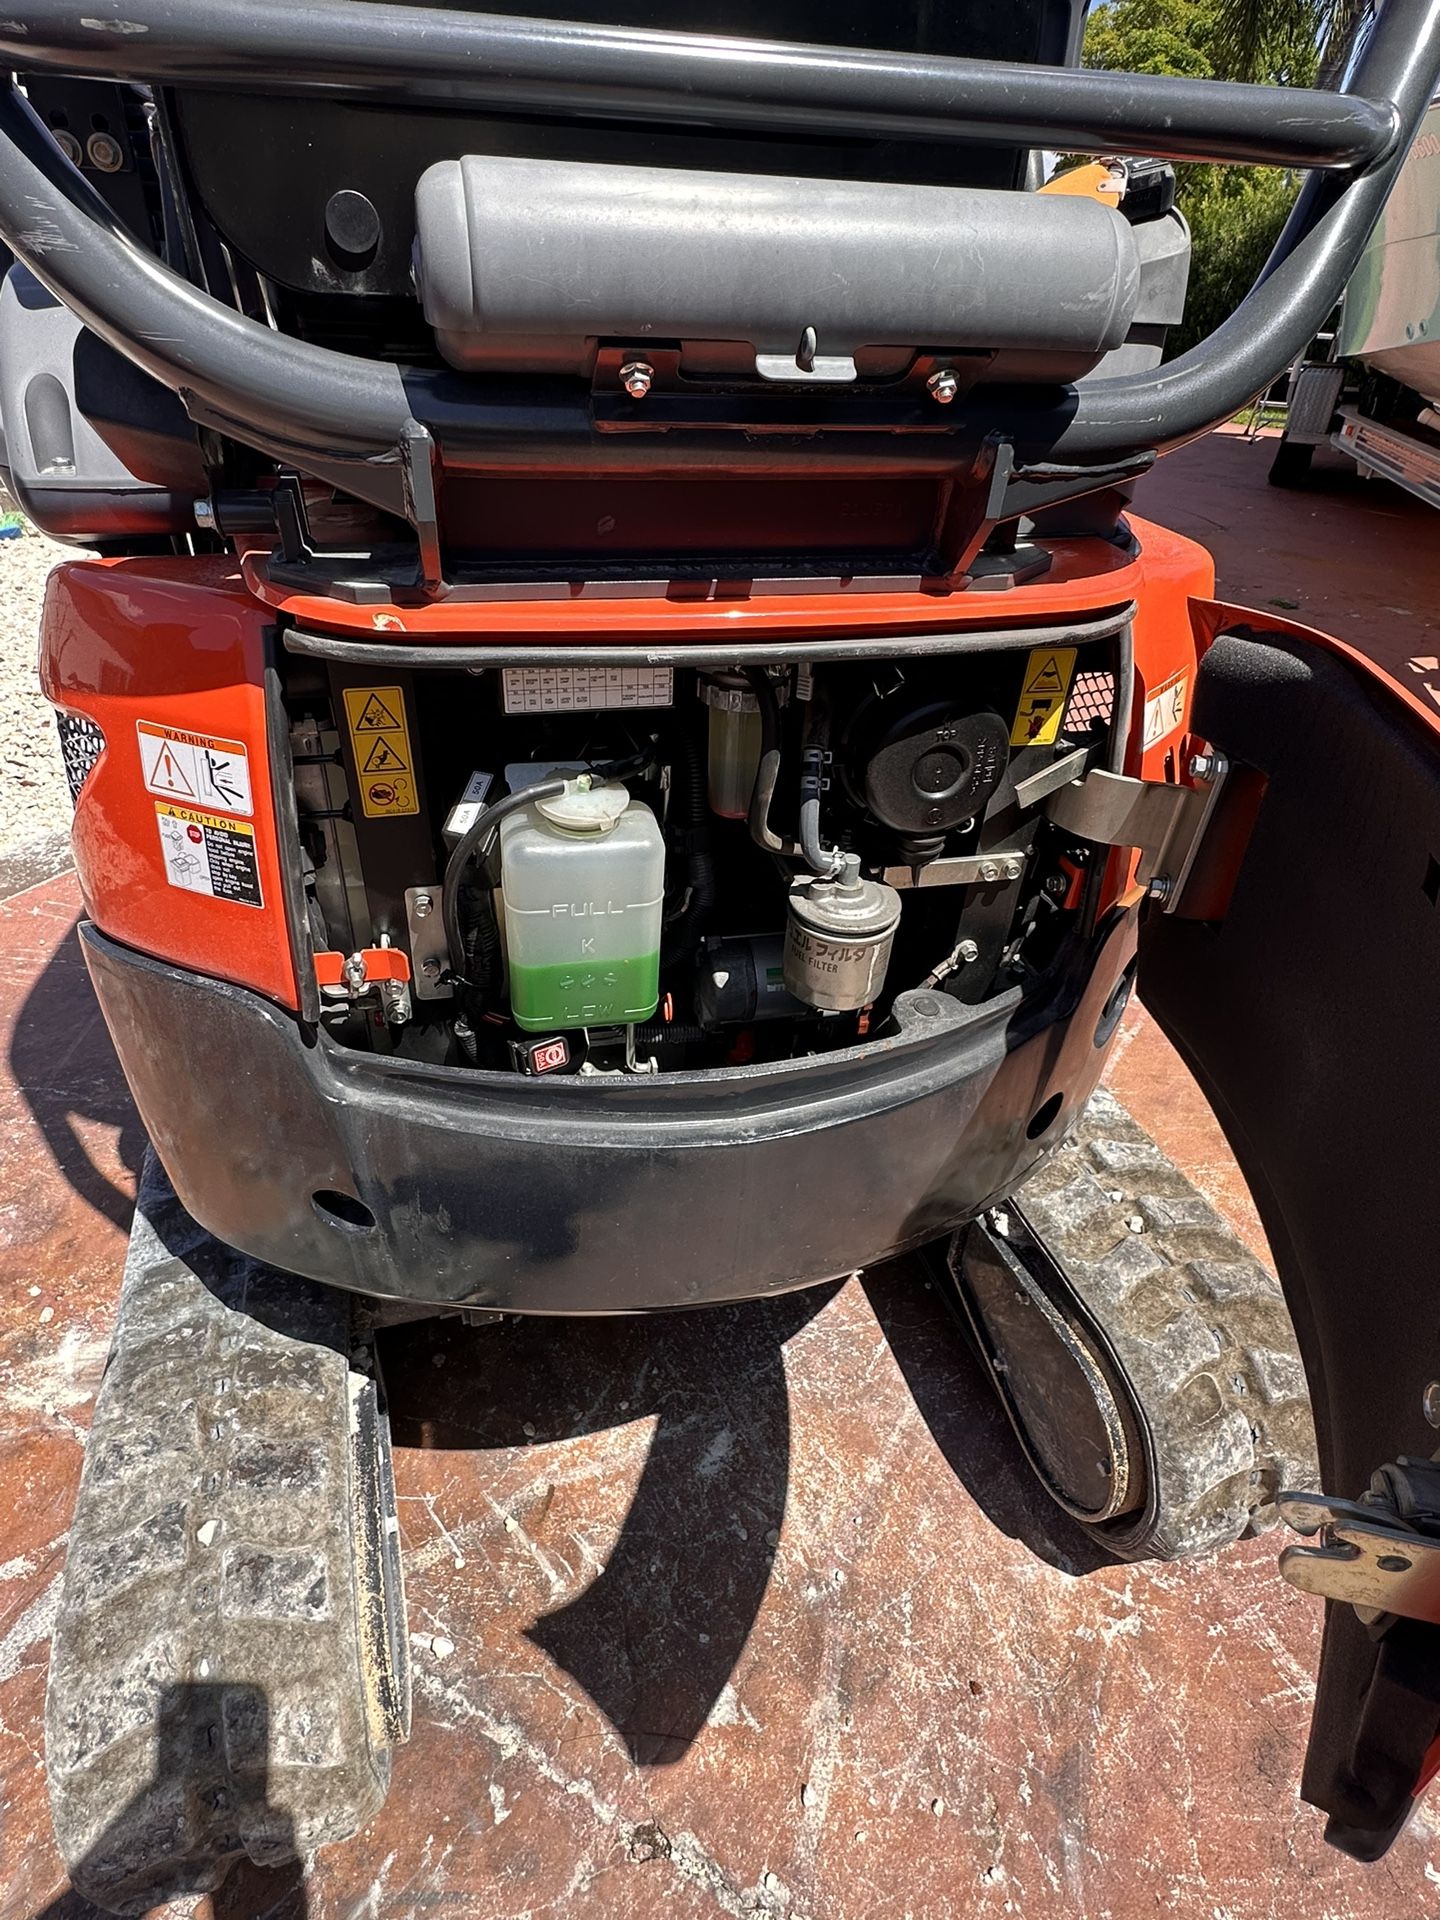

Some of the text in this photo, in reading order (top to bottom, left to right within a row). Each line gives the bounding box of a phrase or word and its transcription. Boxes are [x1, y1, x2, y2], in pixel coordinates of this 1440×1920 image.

[163, 728, 216, 749] WARNING
[936, 729, 957, 742] TOP
[472, 780, 484, 795] 50A
[180, 810, 237, 831] CAUTION
[460, 809, 471, 824] 50A
[551, 901, 625, 919] FULL
[581, 937, 595, 955] K
[808, 957, 839, 974] FILTER
[564, 1003, 614, 1019] LOW
